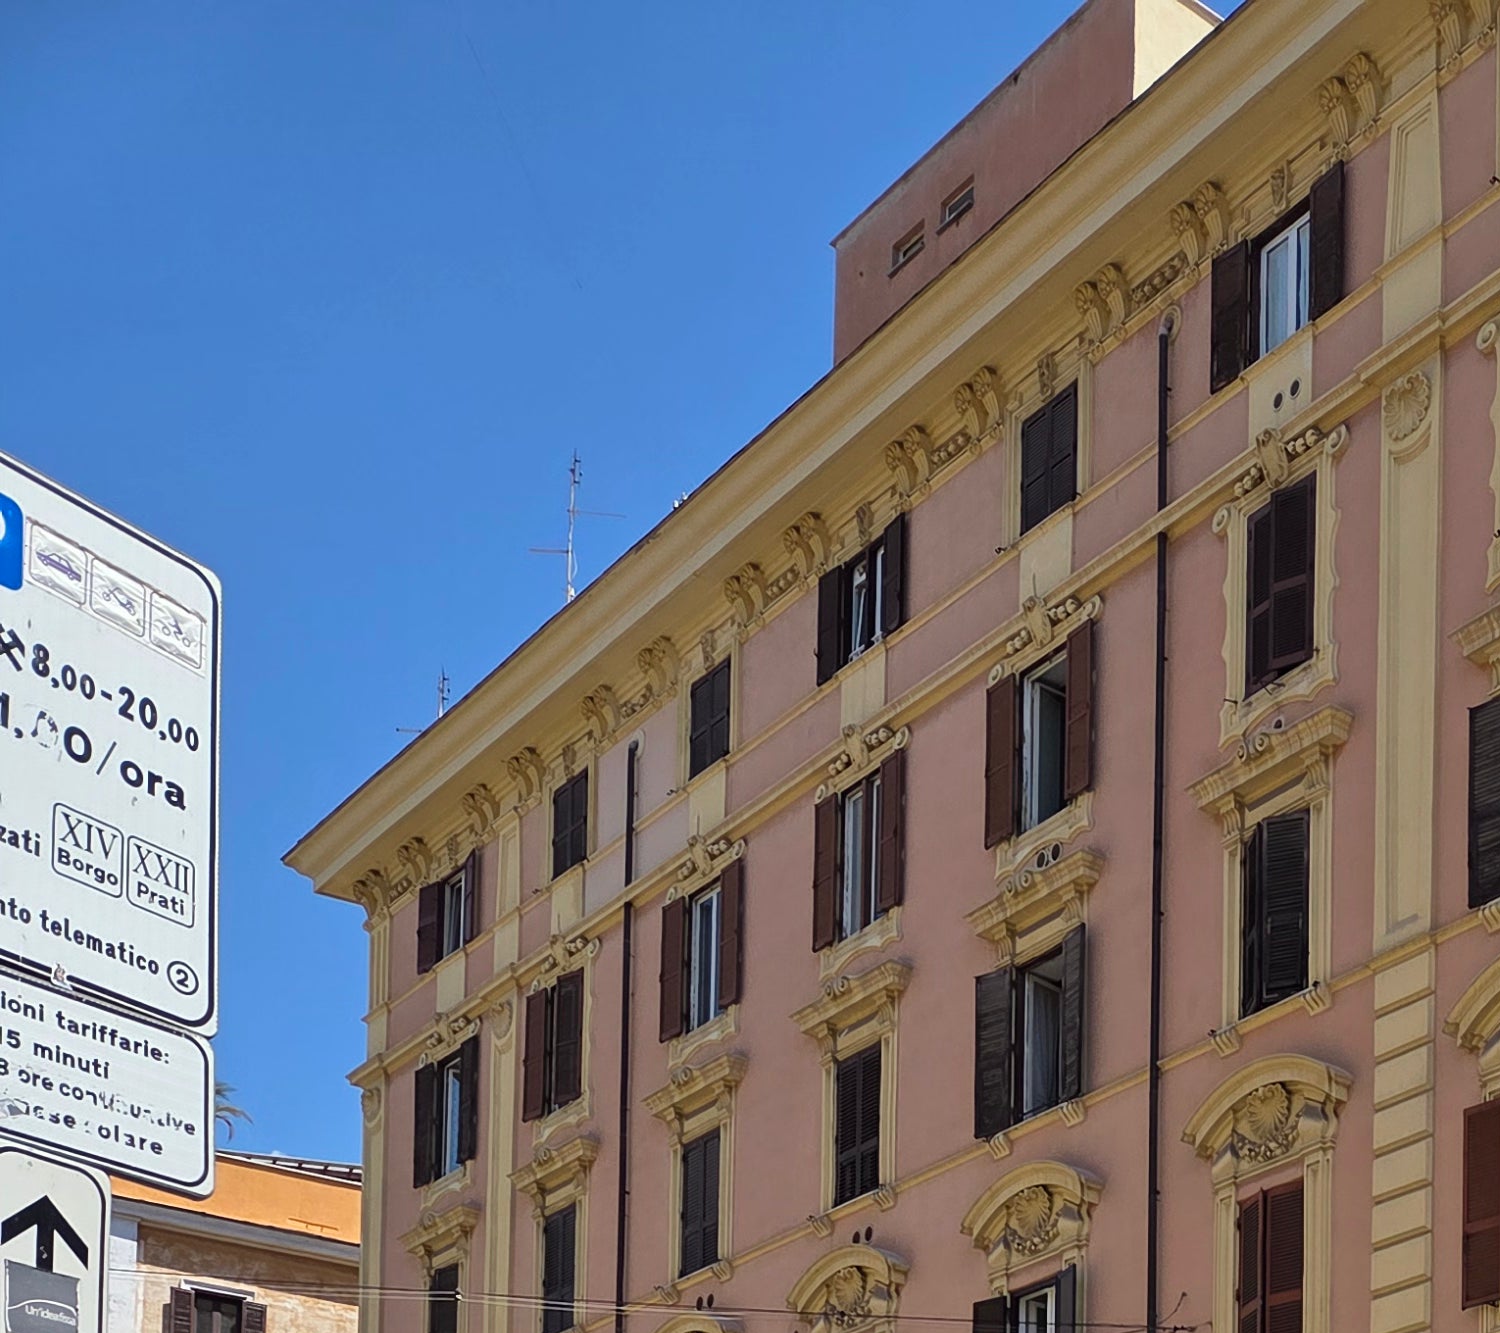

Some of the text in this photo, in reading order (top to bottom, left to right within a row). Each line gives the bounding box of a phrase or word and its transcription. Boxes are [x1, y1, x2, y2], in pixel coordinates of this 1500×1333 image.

[59, 811, 118, 860] XIV
[58, 847, 118, 886] Borgo
[132, 843, 190, 895] XXII
[137, 881, 185, 916] Prati
[39, 909, 160, 975] telematico
[56, 1010, 169, 1064] tariffarie:
[18, 1069, 54, 1091] ore
[33, 1042, 109, 1080] minuti
